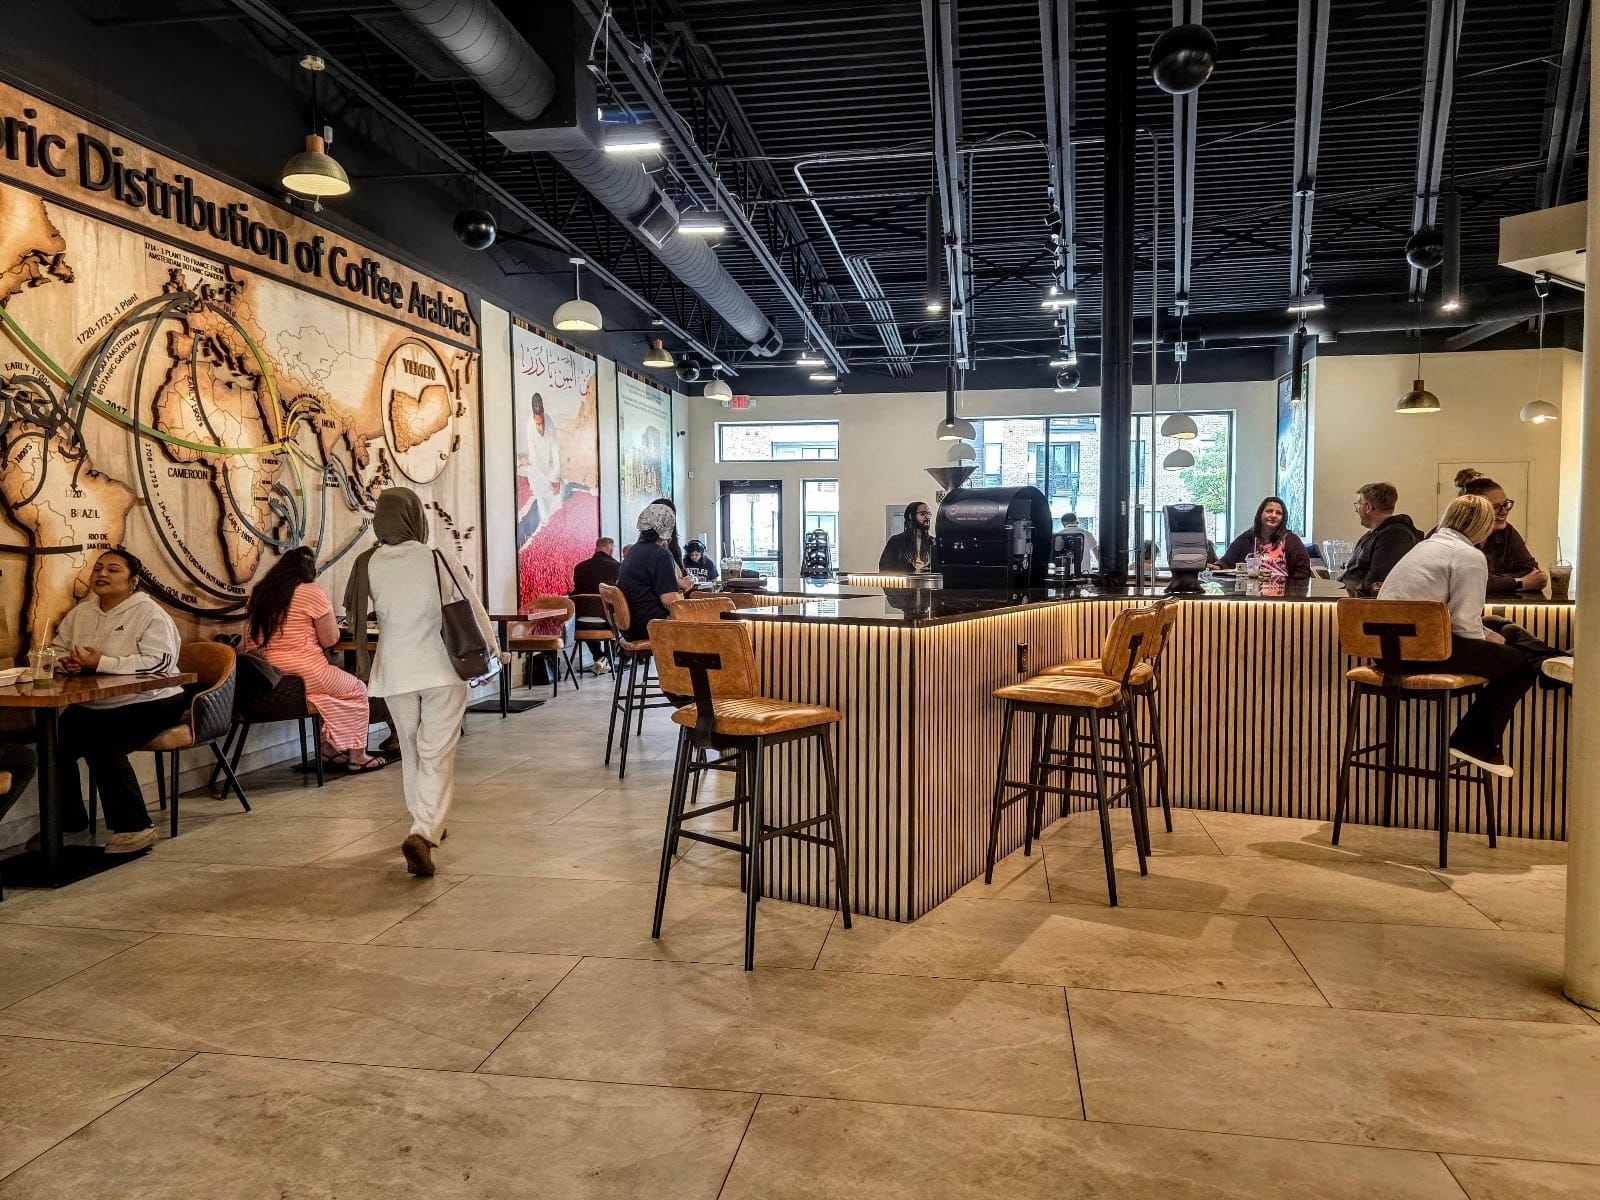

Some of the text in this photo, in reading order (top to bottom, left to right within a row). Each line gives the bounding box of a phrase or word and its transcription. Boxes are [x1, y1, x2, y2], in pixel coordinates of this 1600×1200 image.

[77, 132, 289, 264] Distribution
[294, 235, 324, 277] of
[328, 246, 403, 309] Coffee
[408, 281, 471, 336] Arabica
[149, 252, 181, 267] AMSTERDAM
[204, 271, 224, 281] GARDEN
[191, 258, 209, 270] FRANCE
[210, 264, 224, 275] FROM
[76, 313, 113, 344] 1720-1723
[120, 293, 138, 310] Plant
[106, 328, 140, 362] AMSTERDAM
[5, 361, 30, 372] EARLY
[97, 341, 137, 396] BOTANIC GARDEN
[402, 358, 436, 380] YEMEN
[167, 467, 208, 480] CAMEROON
[88, 533, 109, 541] RIO DE
